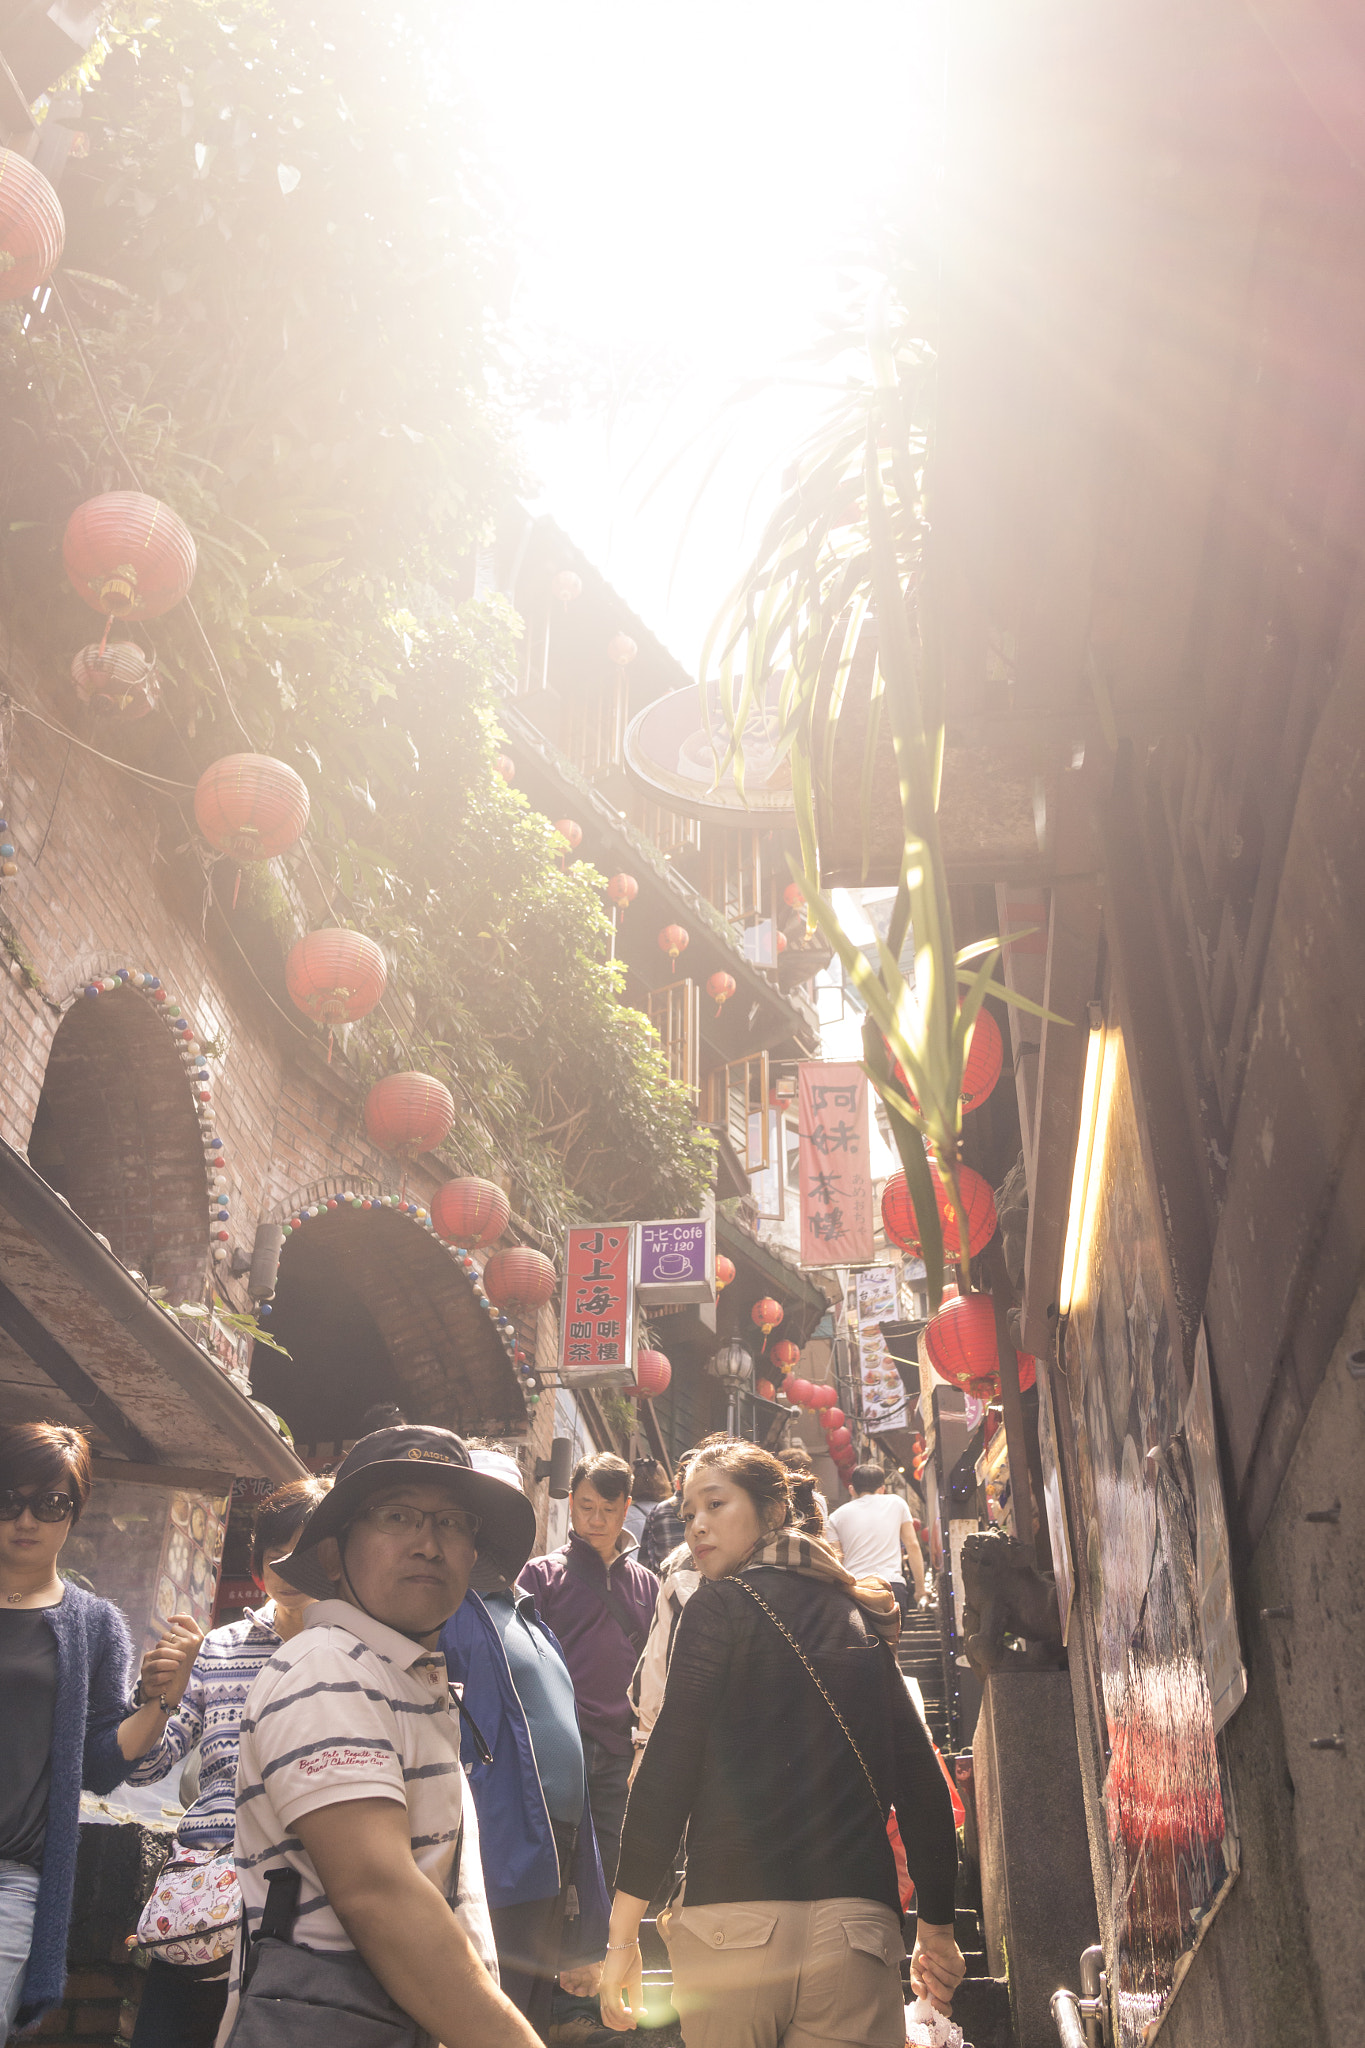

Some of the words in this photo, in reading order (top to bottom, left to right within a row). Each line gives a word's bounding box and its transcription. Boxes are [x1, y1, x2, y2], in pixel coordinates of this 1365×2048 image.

[576, 1232, 621, 1316] 小上海
[423, 1450, 450, 1463] AIGLE
[299, 1758, 319, 1769] Bean
[322, 1750, 339, 1760] Pole
[307, 1759, 329, 1775] Grand
[330, 1757, 368, 1767] Challenge
[370, 1757, 384, 1767] Cup
